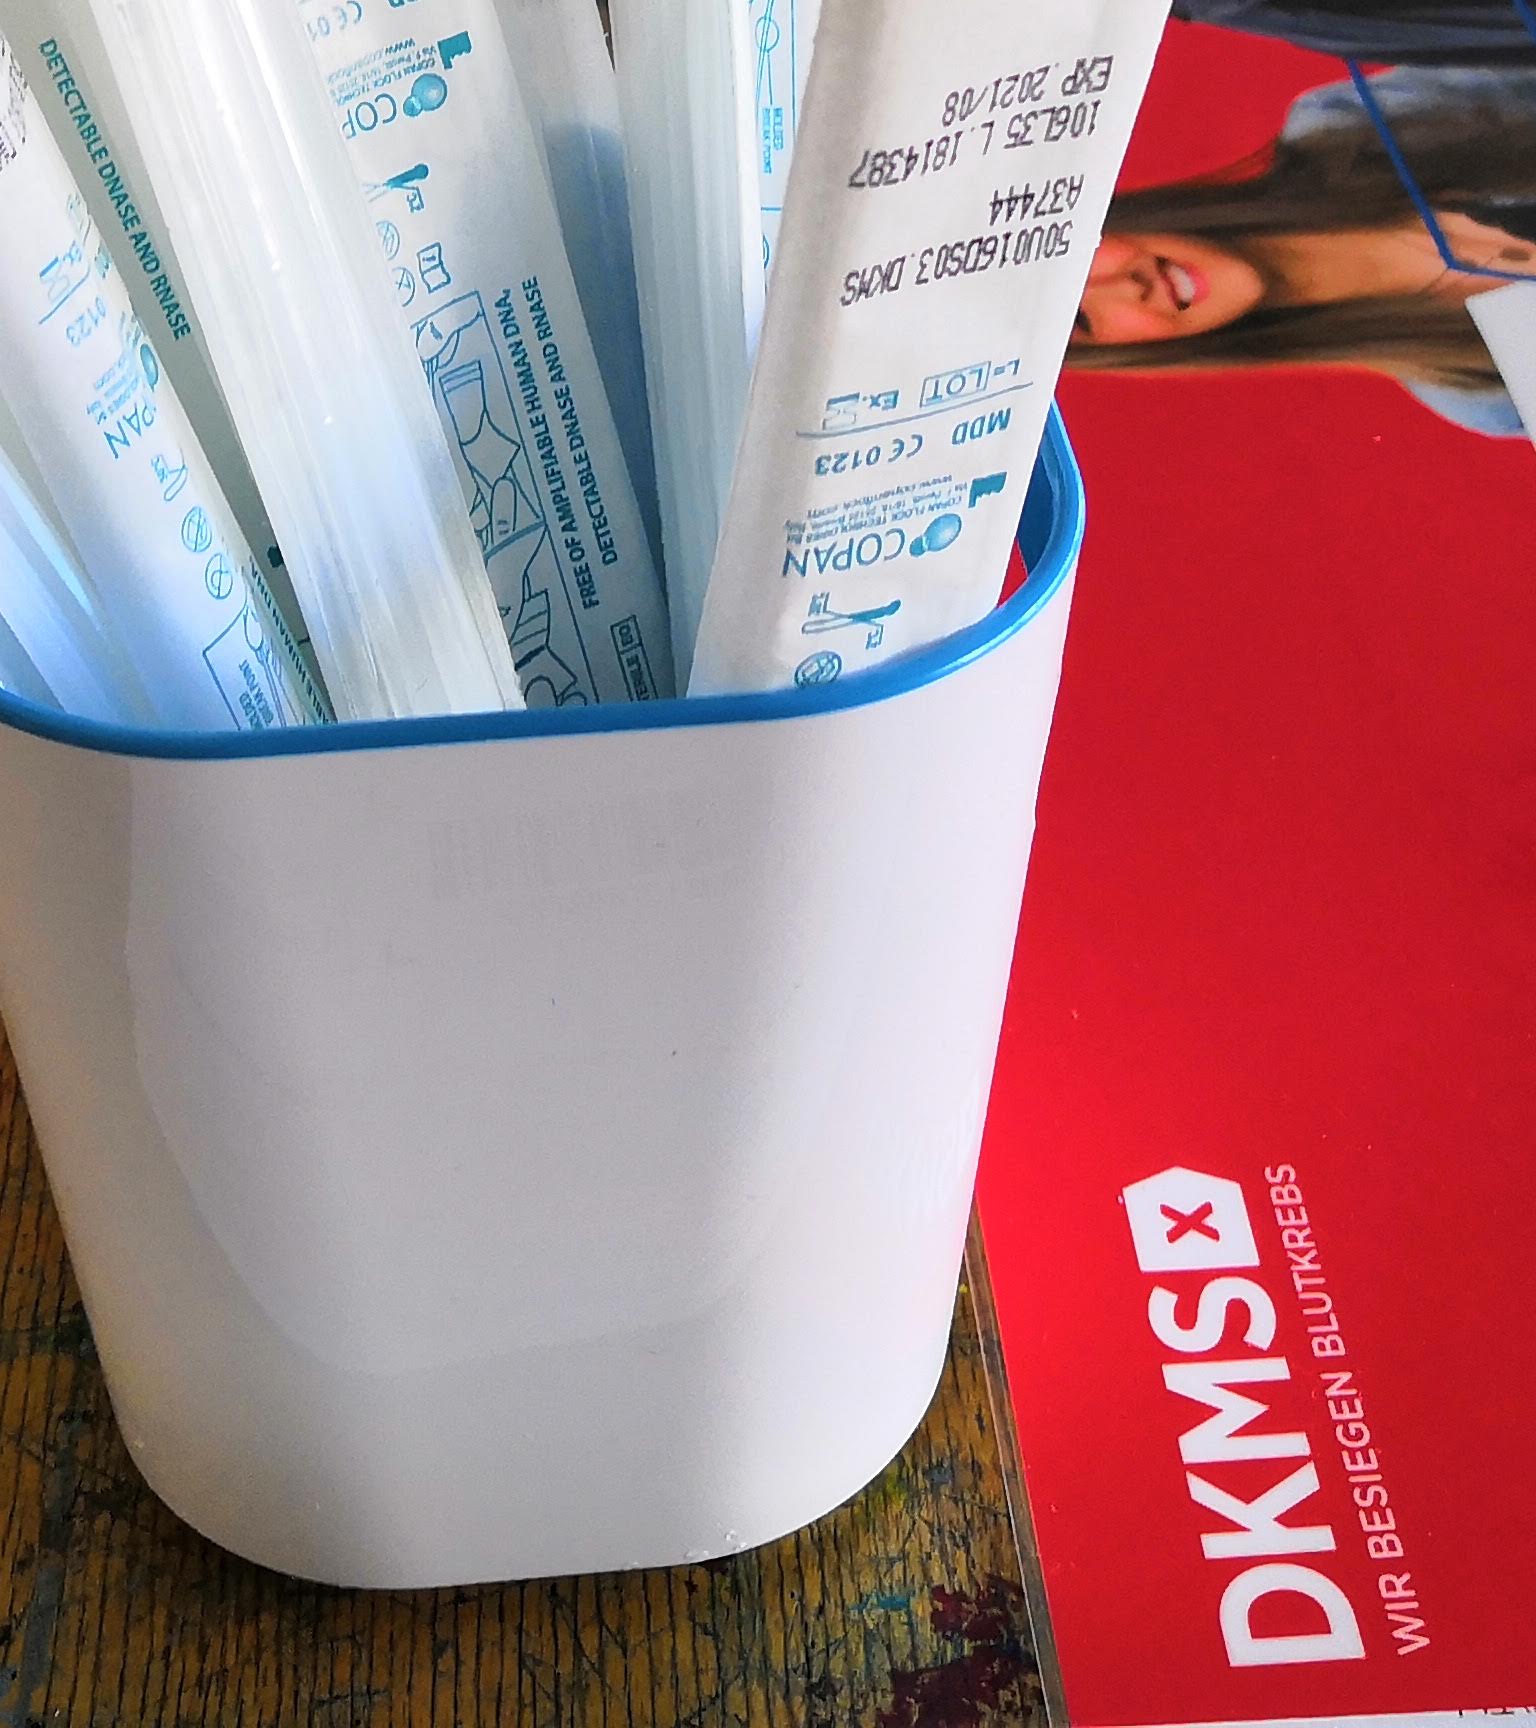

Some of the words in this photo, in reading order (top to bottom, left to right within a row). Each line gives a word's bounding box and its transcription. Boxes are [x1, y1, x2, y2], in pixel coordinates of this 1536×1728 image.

[942, 55, 1113, 127] EXP.2021/08
[838, 120, 995, 190] L.1814387
[1004, 99, 1101, 149] 106L35
[39, 38, 108, 164] DETECTABLE
[98, 160, 140, 232] DNASE
[129, 232, 160, 274] AND
[150, 274, 190, 340] RNASE
[990, 175, 1084, 226] A37444
[495, 289, 520, 339] DNA,
[522, 276, 553, 341] RNASE
[508, 339, 542, 414] HUMAN
[543, 342, 566, 382] AND
[922, 368, 988, 403] LOT
[554, 385, 584, 452] DNASE
[952, 408, 1011, 445] MDD
[530, 413, 578, 532] AMPLIFIABLE
[815, 446, 880, 476] 0123
[574, 450, 618, 566] DETECTABLE
[891, 506, 925, 521] FLOCK
[565, 537, 585, 562] OF
[780, 527, 912, 582] COPAN
[574, 562, 599, 609] FREE
[1264, 1163, 1347, 1360] BLUTKREBS
[1148, 1276, 1366, 1668] DKMS
[1331, 1371, 1406, 1561] BESIEGEN
[1377, 1572, 1431, 1656] WIR
